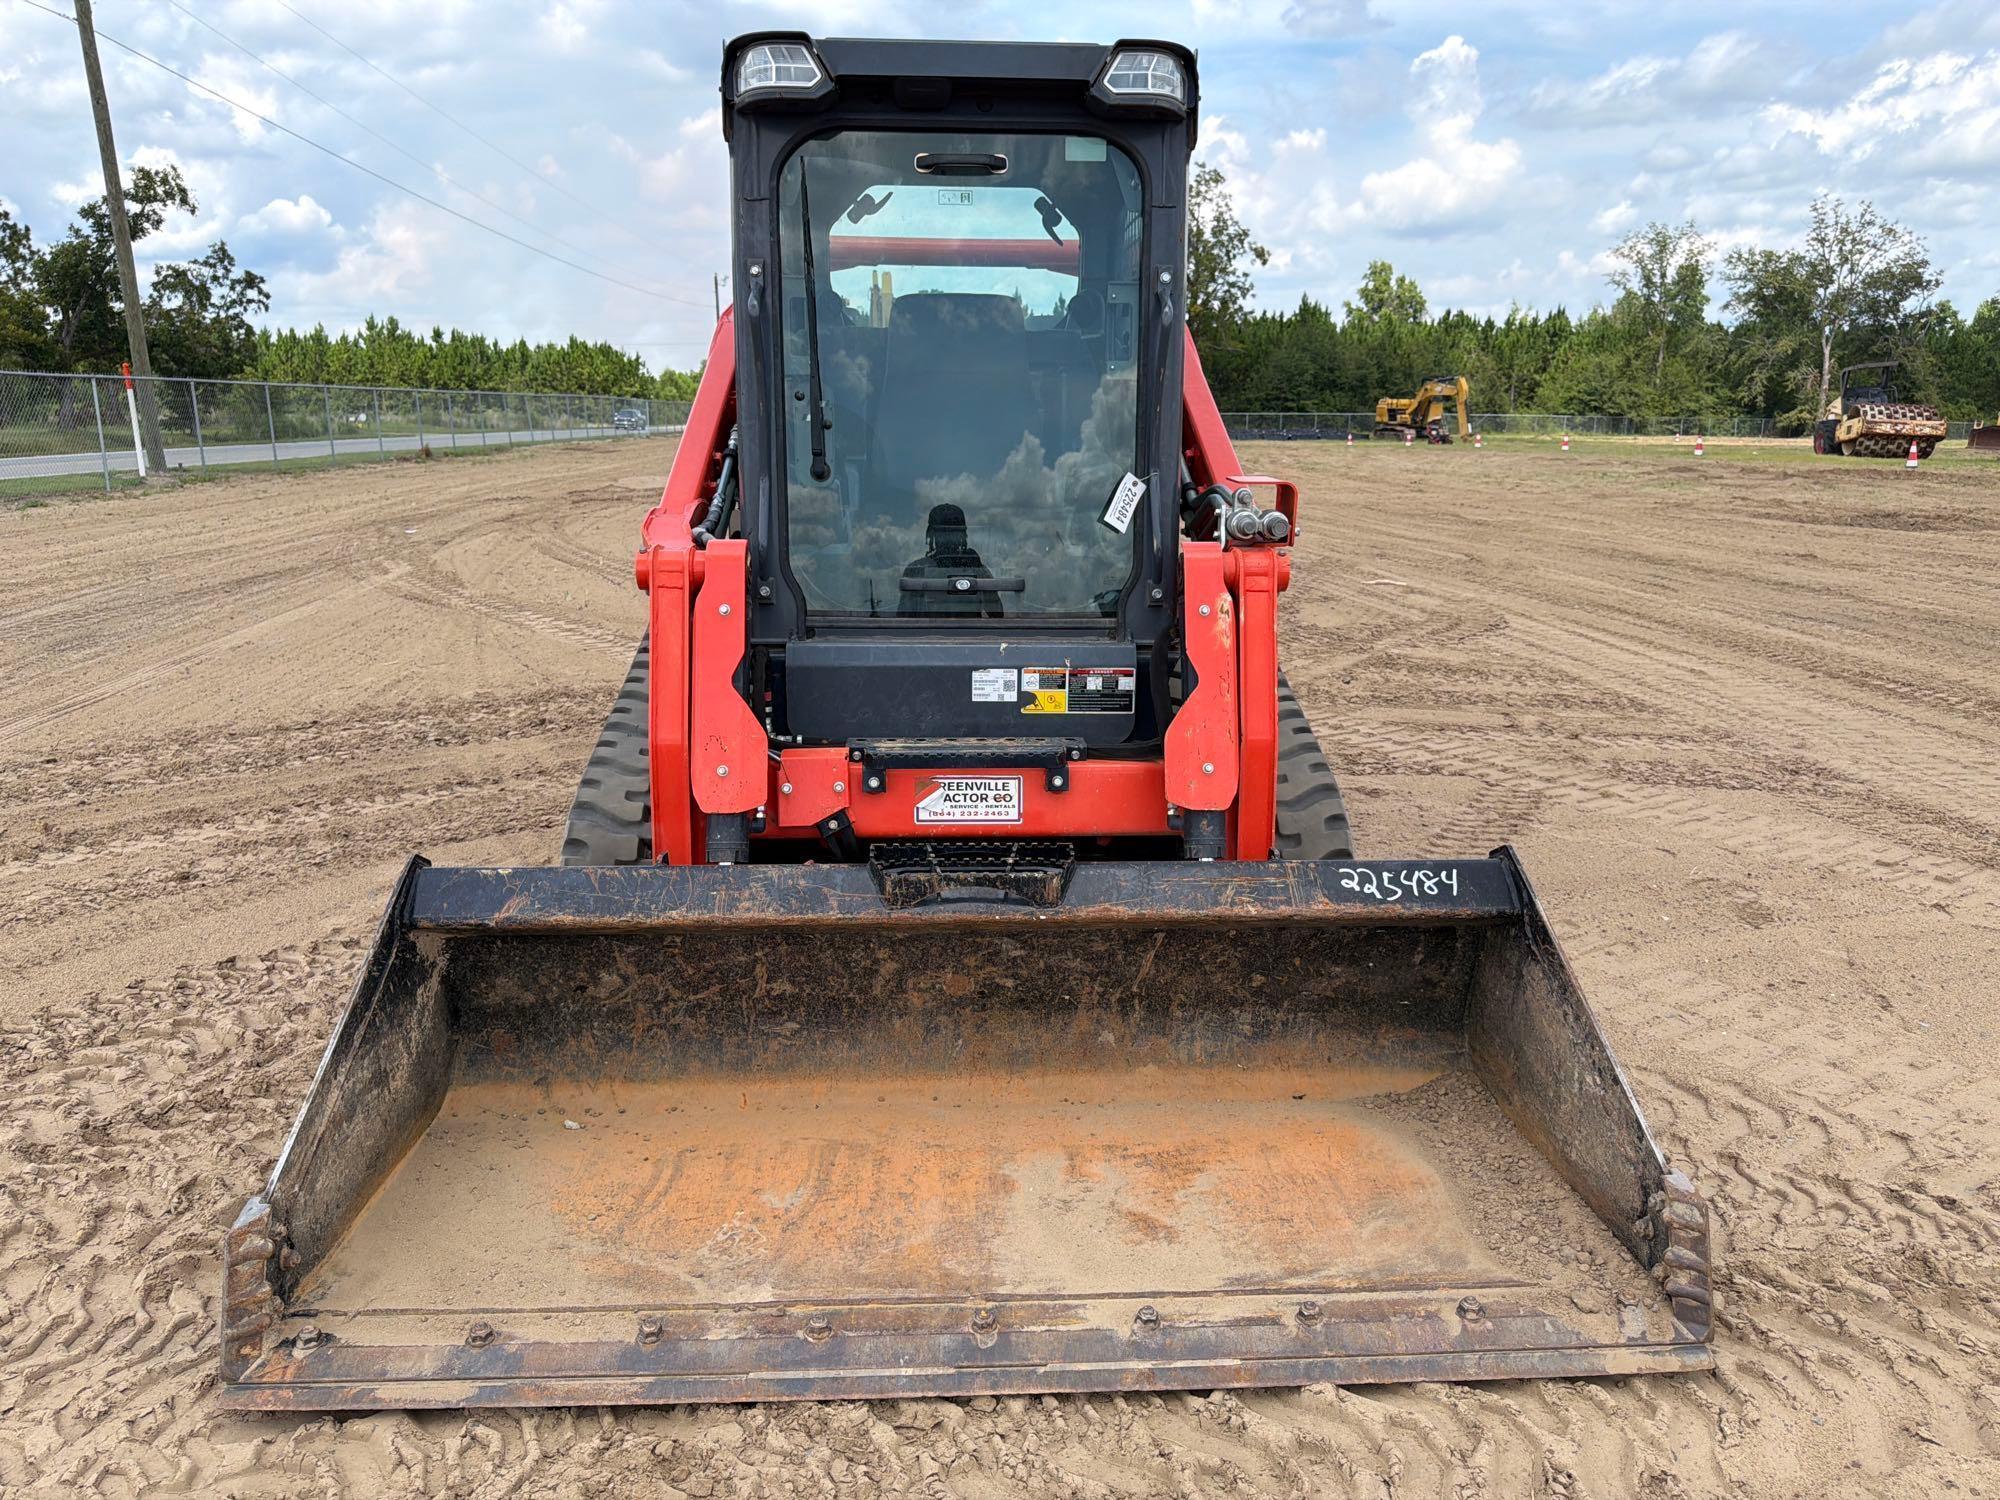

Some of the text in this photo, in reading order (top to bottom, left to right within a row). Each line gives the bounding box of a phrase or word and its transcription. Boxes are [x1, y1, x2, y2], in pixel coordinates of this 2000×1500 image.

[1116, 488, 1137, 524] 225484
[940, 782, 1010, 791] REENVILLE
[943, 793, 1013, 803] ACTOR CO
[1337, 868, 1458, 901] 225484
